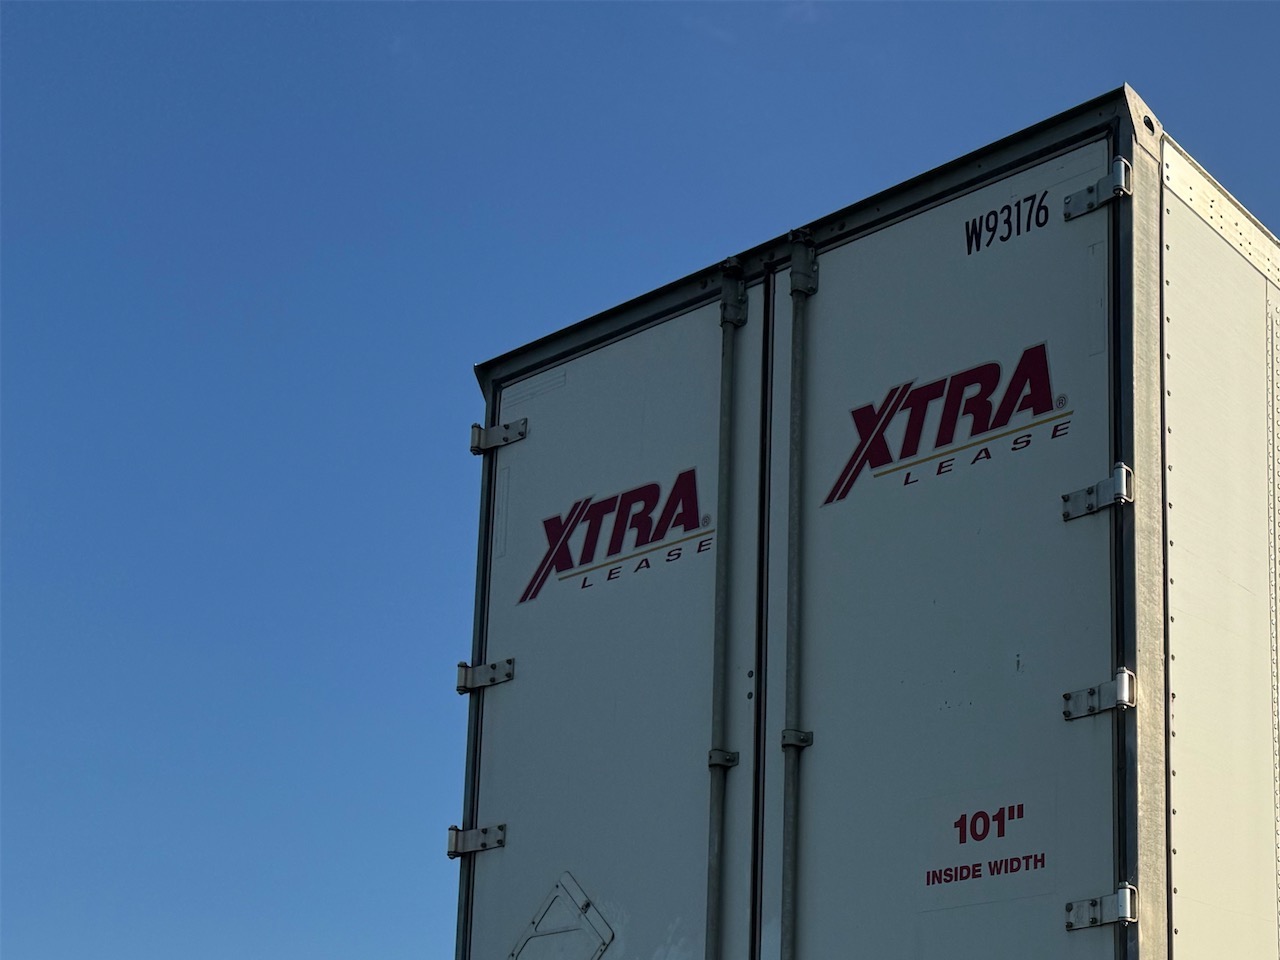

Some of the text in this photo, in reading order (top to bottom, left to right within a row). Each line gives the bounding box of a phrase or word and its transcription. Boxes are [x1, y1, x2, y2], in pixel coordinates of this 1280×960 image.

[965, 190, 1049, 256] W93176
[820, 342, 1054, 506] XTRA
[903, 420, 1072, 486] LEASE
[518, 468, 700, 604] XTRA
[581, 537, 713, 589] LEASE
[953, 803, 1024, 845] 101"
[926, 853, 1045, 886] INSIDE WIDTH
